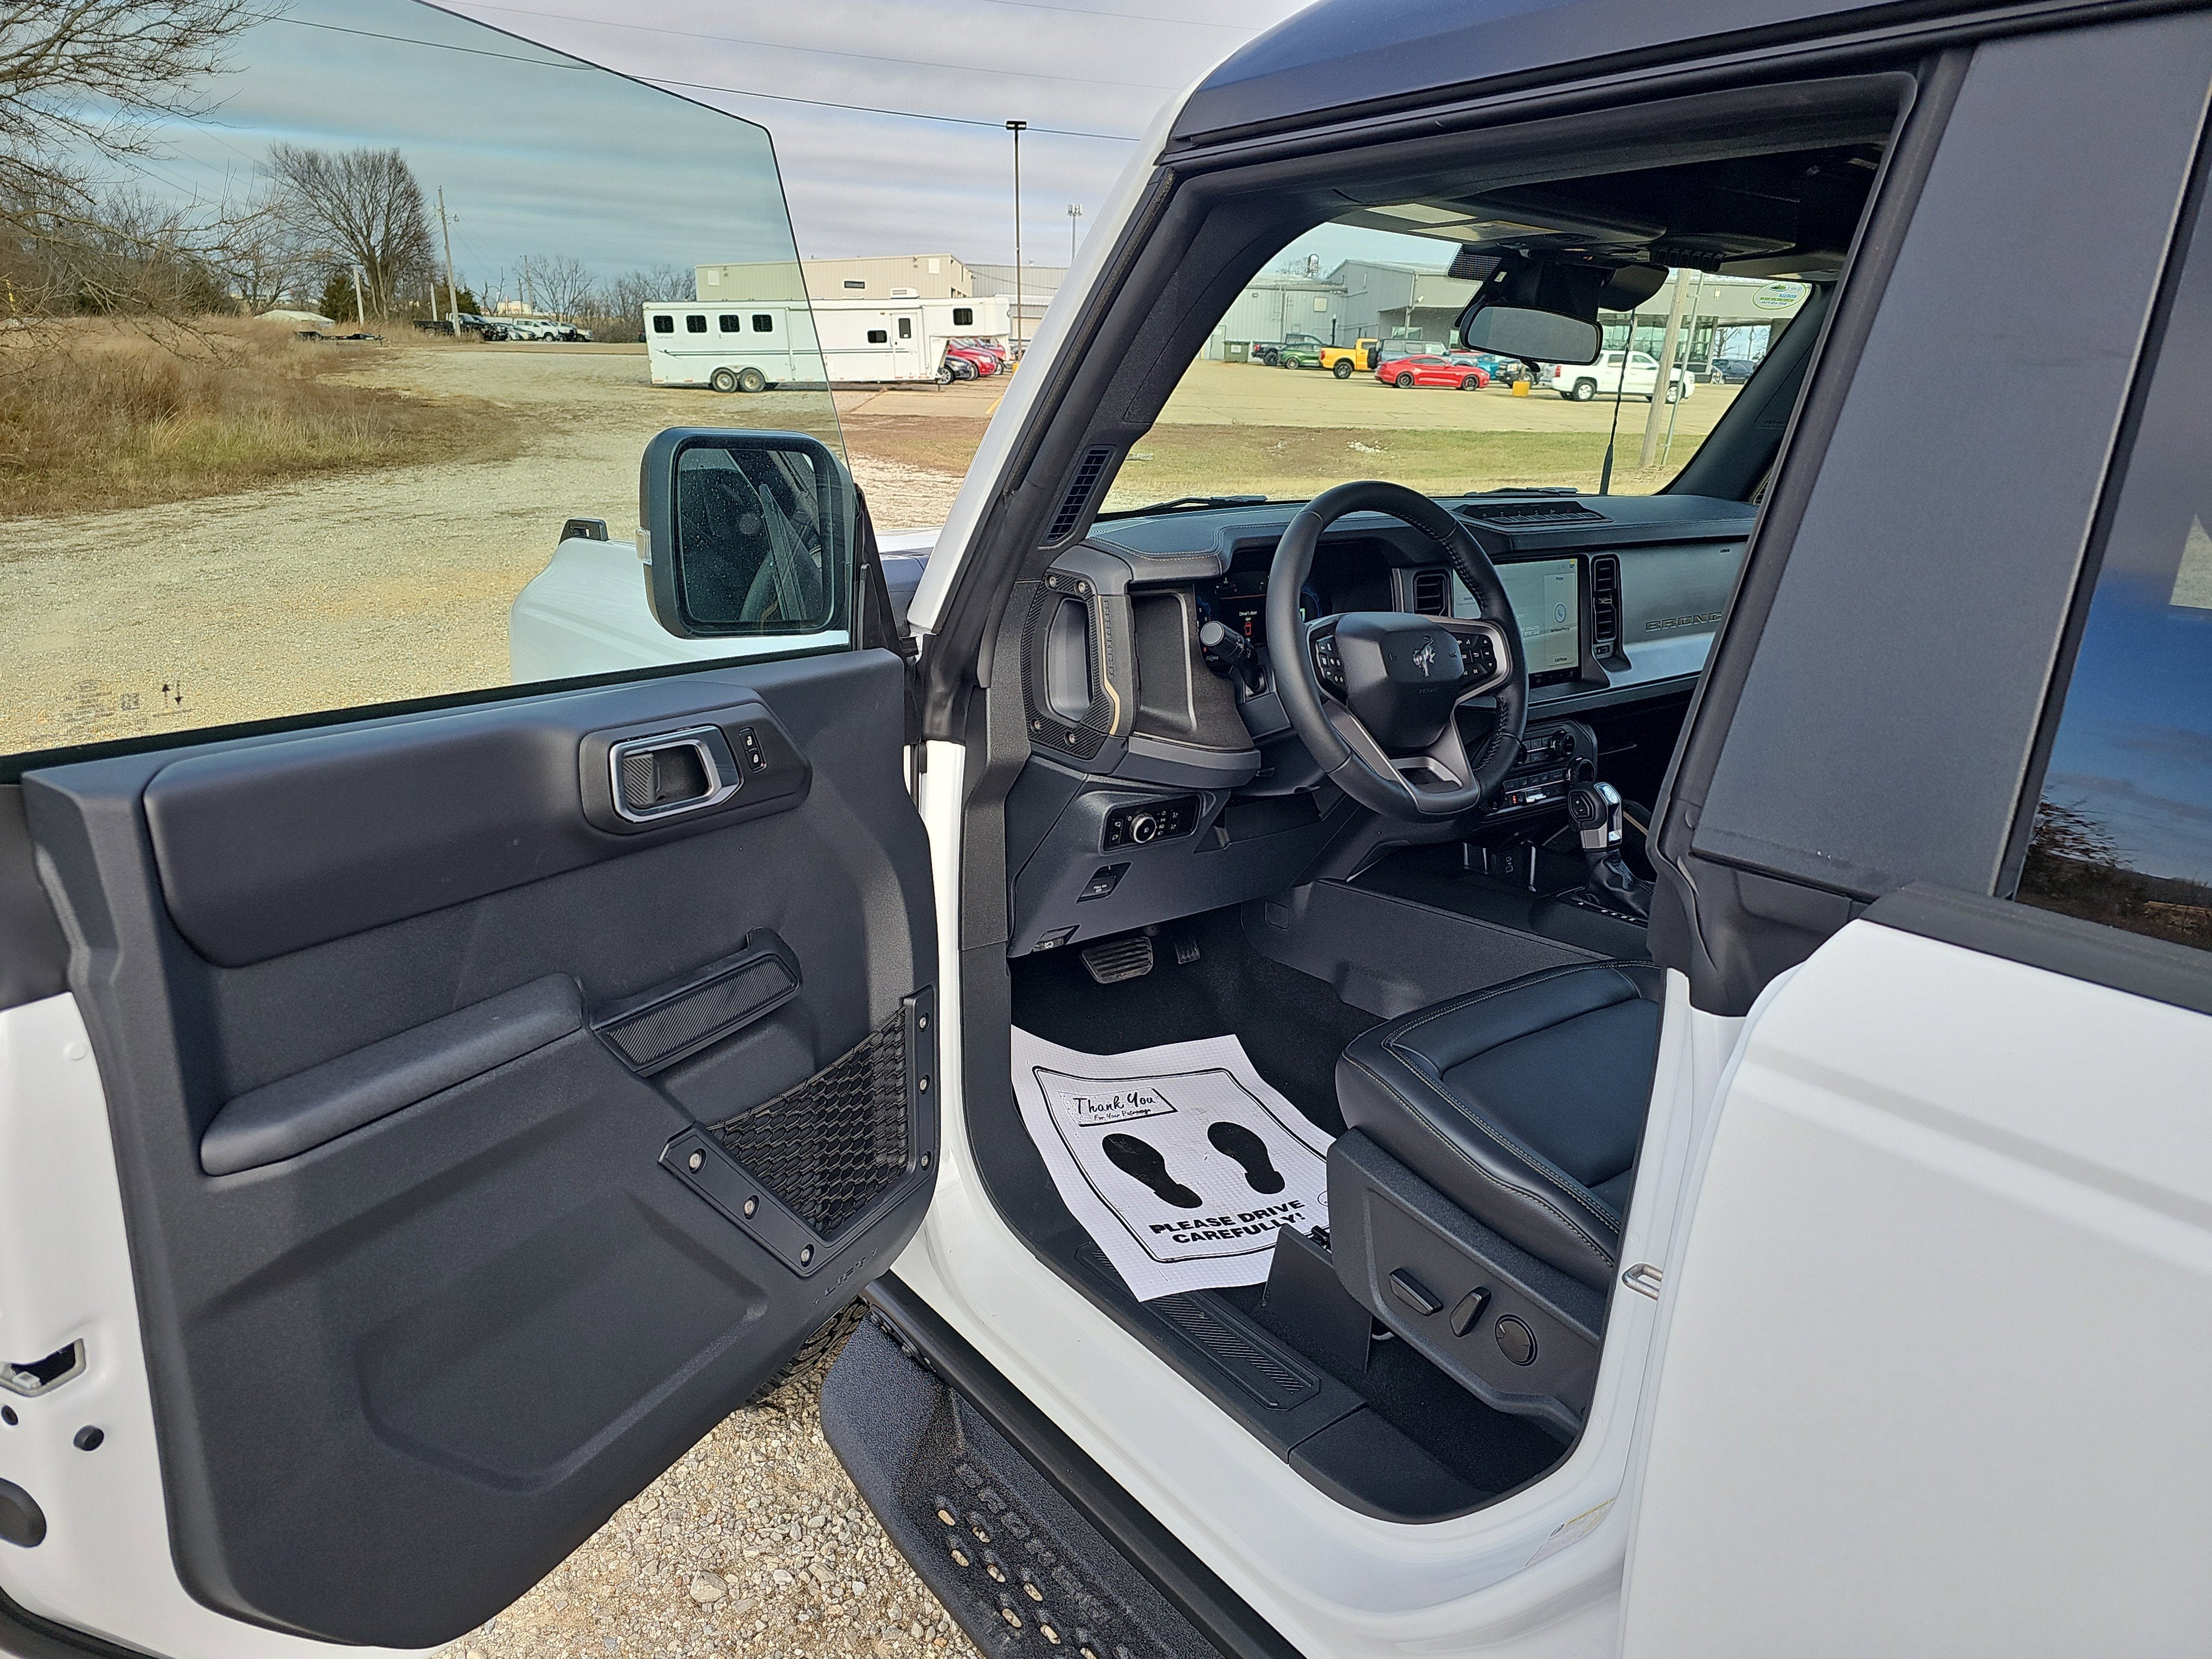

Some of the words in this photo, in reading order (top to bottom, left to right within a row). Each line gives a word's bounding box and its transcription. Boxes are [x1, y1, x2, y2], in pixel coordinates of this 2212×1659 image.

[1645, 611, 1723, 632] BRONC
[1073, 1095, 1124, 1115] Thank
[1127, 1092, 1156, 1108] You
[1122, 1109, 1152, 1117] Patronage
[1148, 1216, 1234, 1234] PLEASE
[1238, 1200, 1306, 1225] DRIVE
[1172, 1212, 1307, 1244] CAREFULLY!
